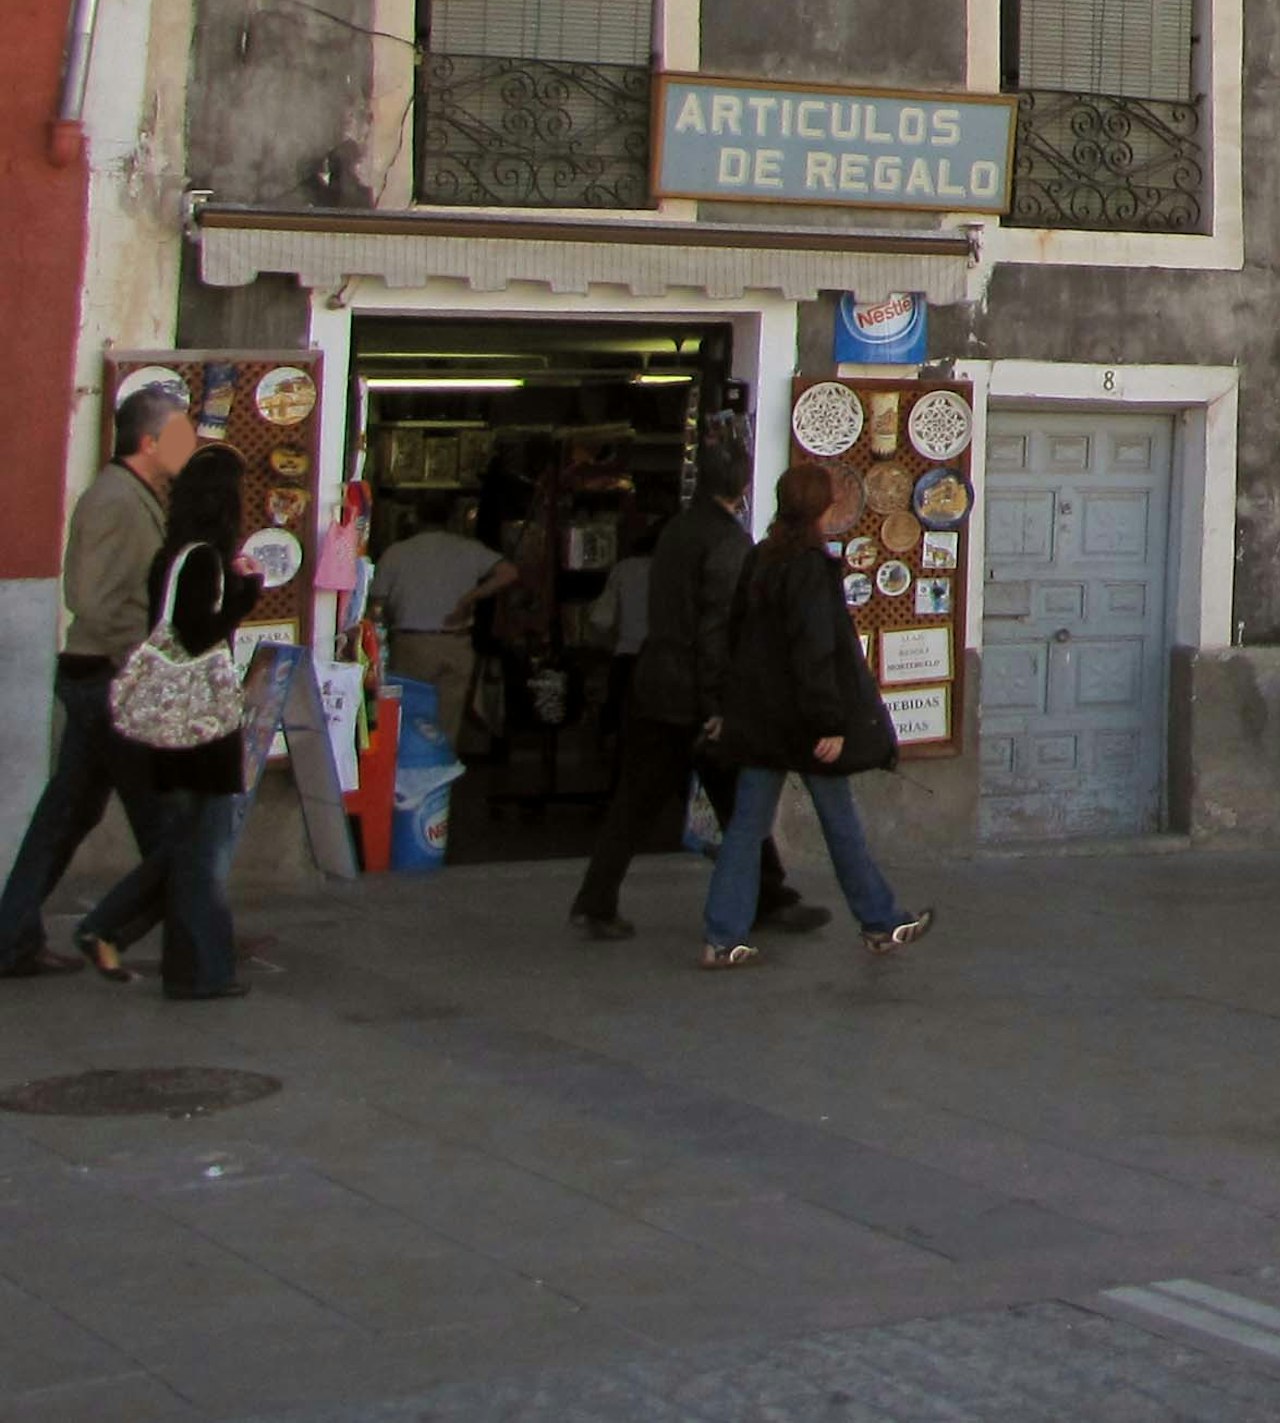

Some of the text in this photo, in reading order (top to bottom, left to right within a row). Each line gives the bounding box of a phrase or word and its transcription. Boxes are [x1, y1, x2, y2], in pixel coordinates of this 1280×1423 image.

[675, 92, 961, 147] ARTICULOS
[717, 147, 999, 198] DE REGALO
[1103, 370, 1114, 391] 8
